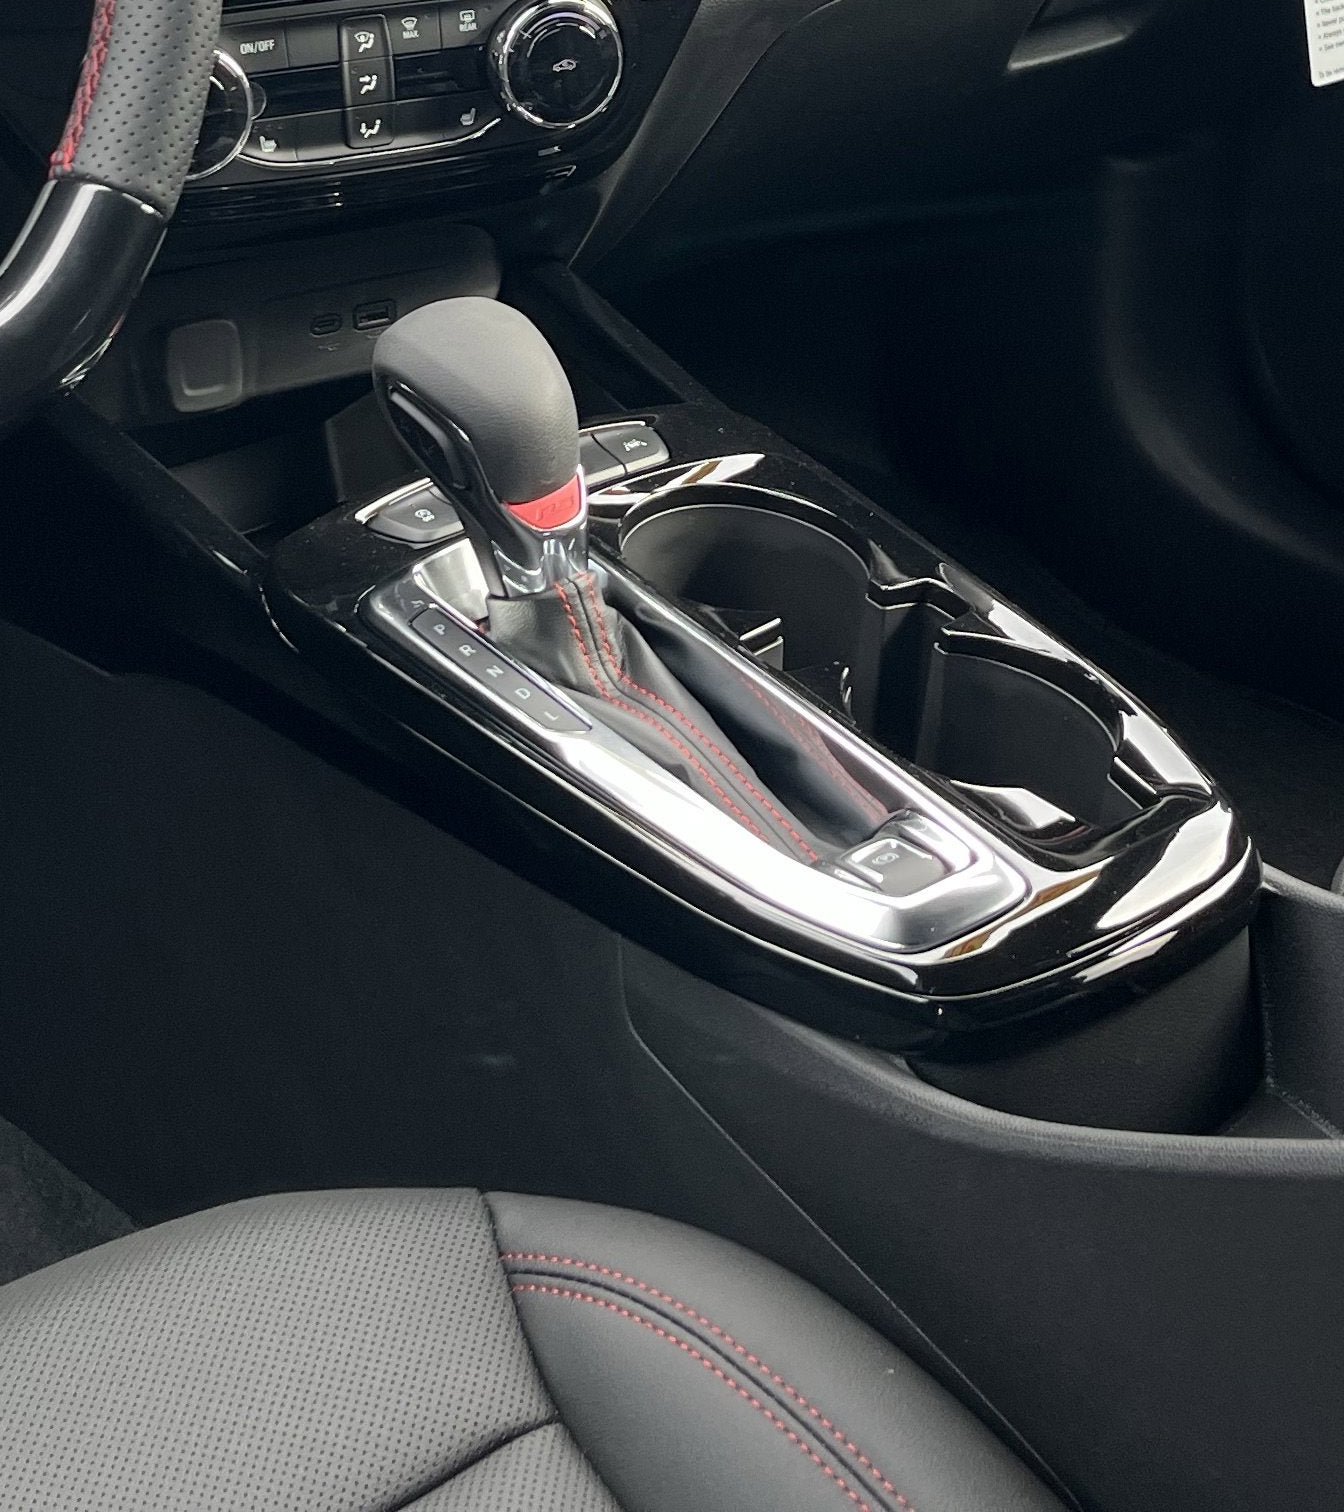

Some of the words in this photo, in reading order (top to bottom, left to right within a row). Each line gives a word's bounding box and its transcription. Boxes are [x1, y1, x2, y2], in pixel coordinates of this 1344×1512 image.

[459, 21, 478, 32] REAR
[402, 29, 420, 40] MAX
[239, 38, 276, 55] ON/OFF
[432, 623, 446, 636] P
[458, 644, 477, 657] R
[485, 665, 505, 678] N
[514, 687, 531, 700] D
[544, 710, 560, 721] L
